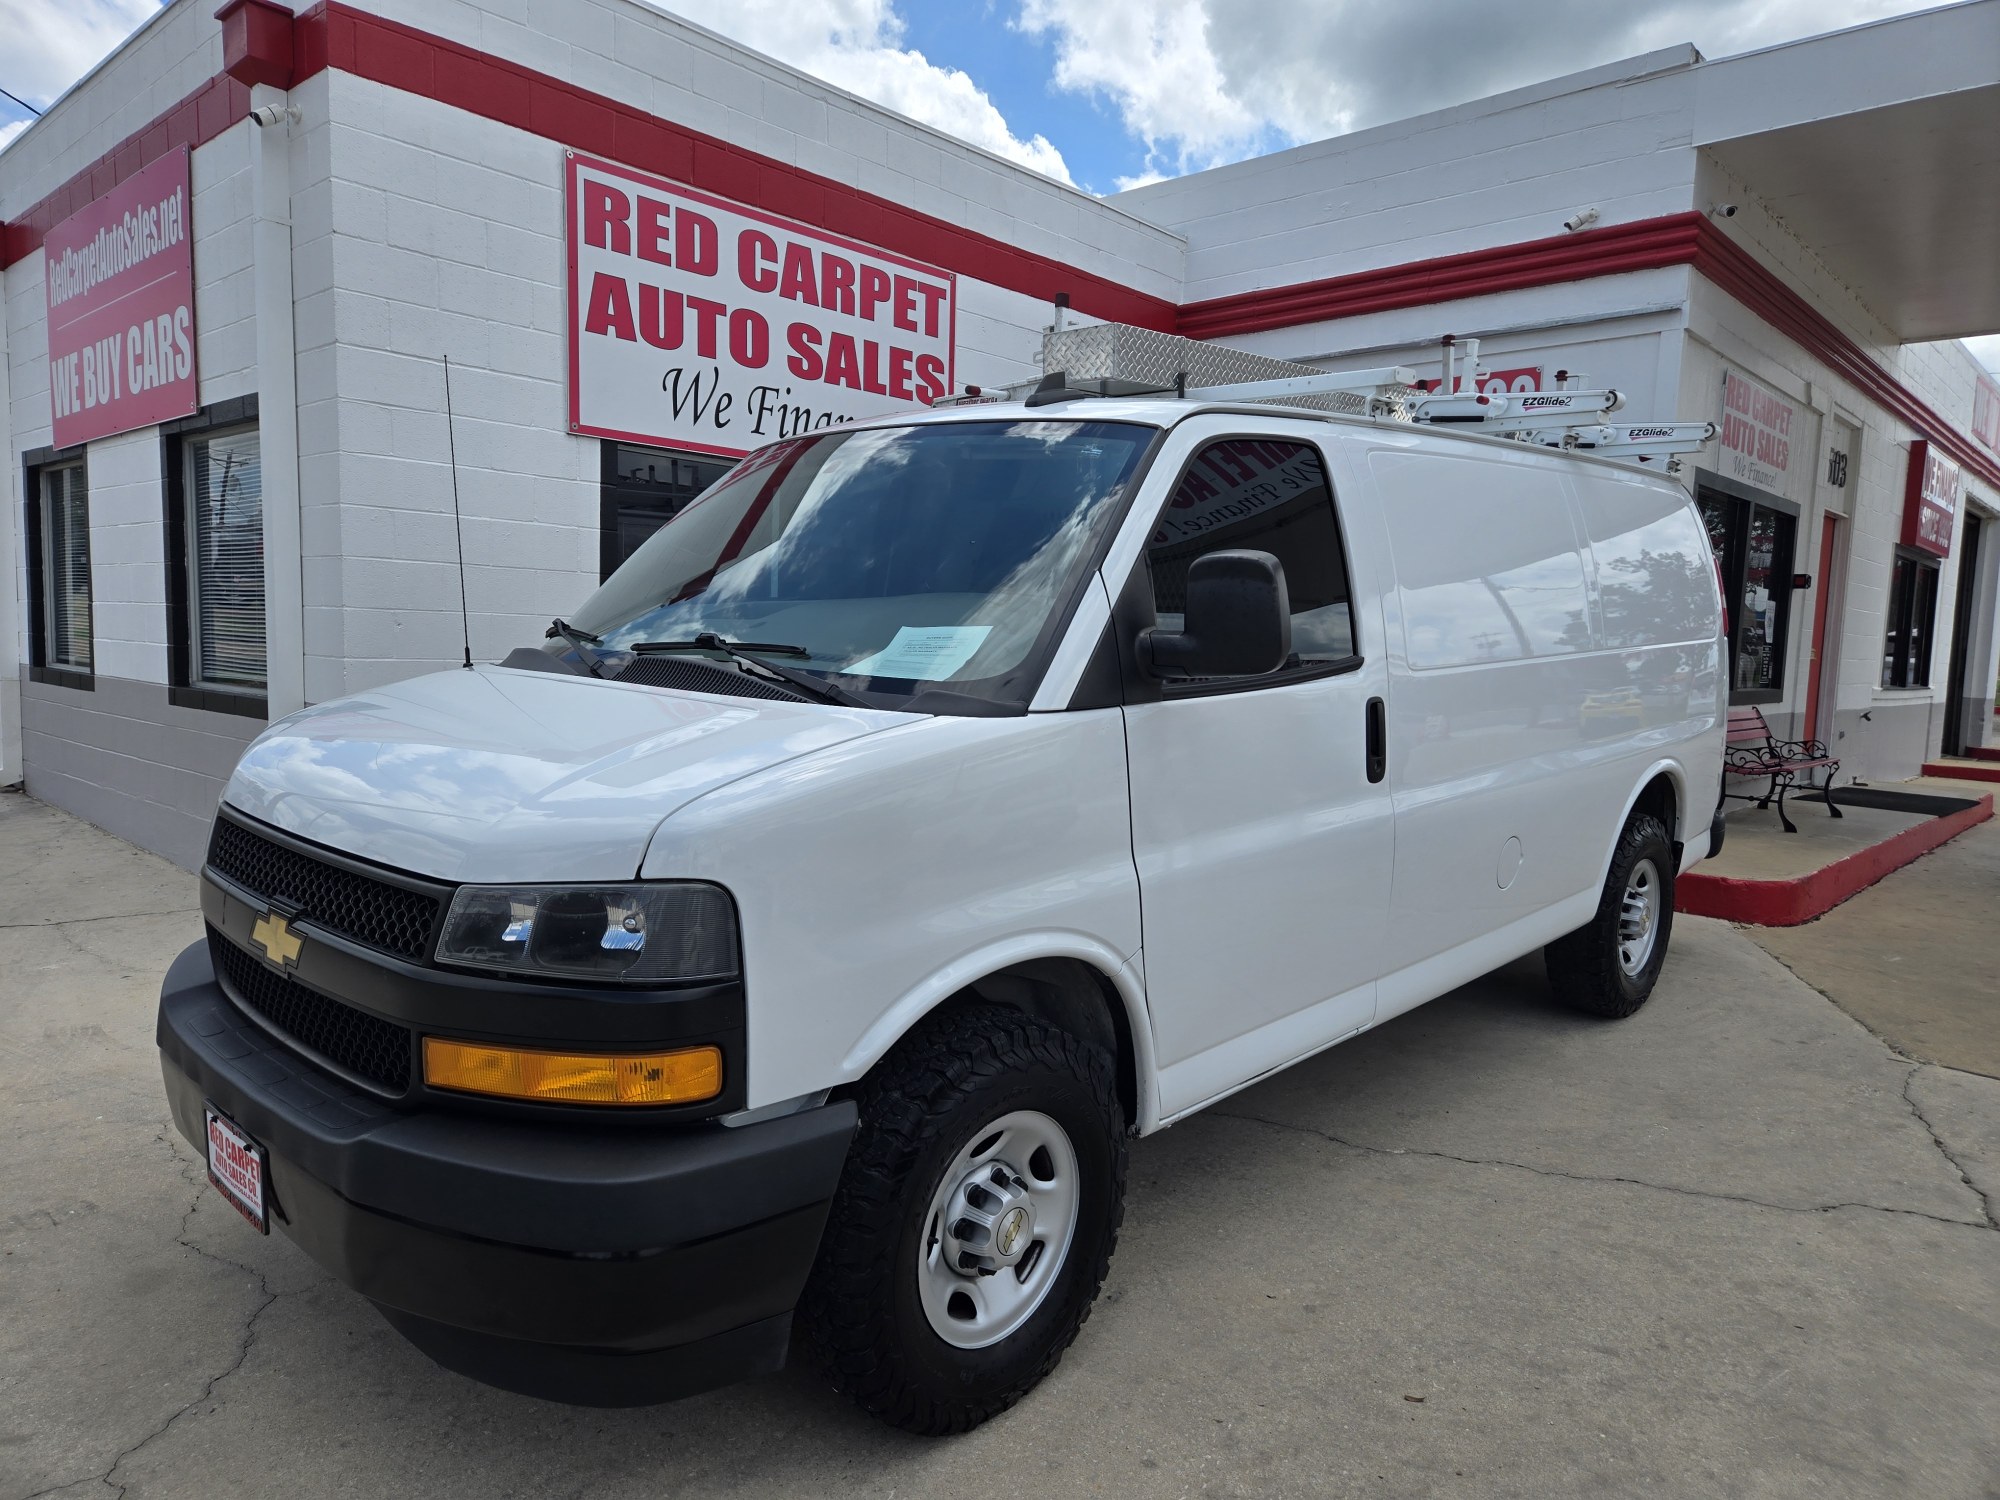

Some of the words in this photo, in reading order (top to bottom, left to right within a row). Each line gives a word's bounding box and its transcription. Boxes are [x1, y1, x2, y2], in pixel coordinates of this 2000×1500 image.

[50, 185, 184, 308] RedCarpetAutoSales.net
[584, 178, 718, 277] RED
[738, 229, 947, 339] CARPET
[52, 352, 81, 418] WE
[83, 333, 121, 408] BUY
[127, 306, 191, 395] CARS
[585, 271, 769, 369] AUTO
[787, 322, 945, 406] SALES
[662, 366, 733, 429] We
[748, 386, 854, 439] Fina
[1522, 396, 1572, 407] EZGlide2
[1629, 427, 1674, 437] EZGlide2
[1725, 374, 1751, 415] RED
[1752, 389, 1792, 437] CARPET
[1721, 412, 1755, 457] AUTO
[1757, 428, 1789, 471] SALES
[1733, 455, 1747, 477] We
[209, 1119, 224, 1151] RED
[225, 1138, 261, 1183] CARPET
[228, 1161, 247, 1189] SALES
